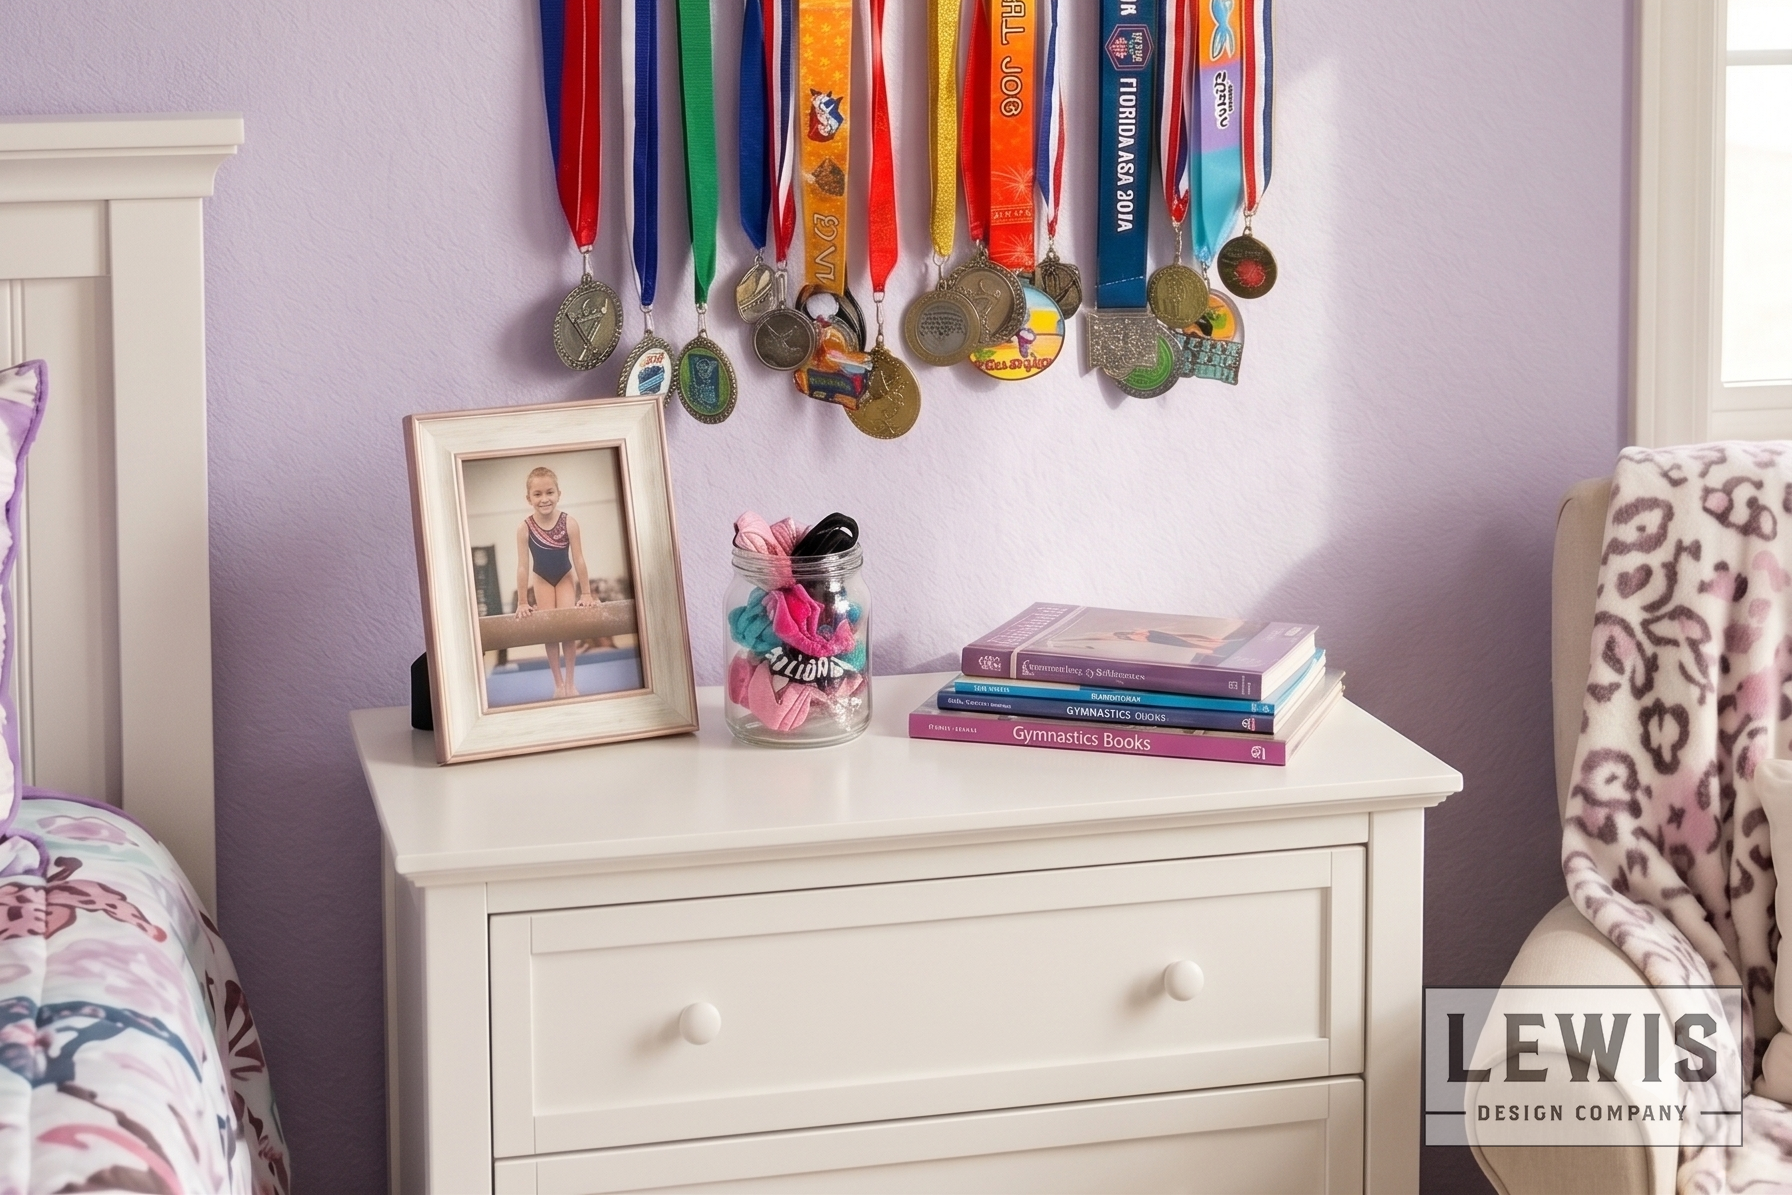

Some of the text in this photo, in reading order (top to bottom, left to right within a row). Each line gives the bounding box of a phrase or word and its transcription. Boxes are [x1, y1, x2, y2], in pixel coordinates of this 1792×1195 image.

[1066, 706, 1131, 720] GYMNASTICS
[1013, 725, 1151, 751] Gymnastics Books
